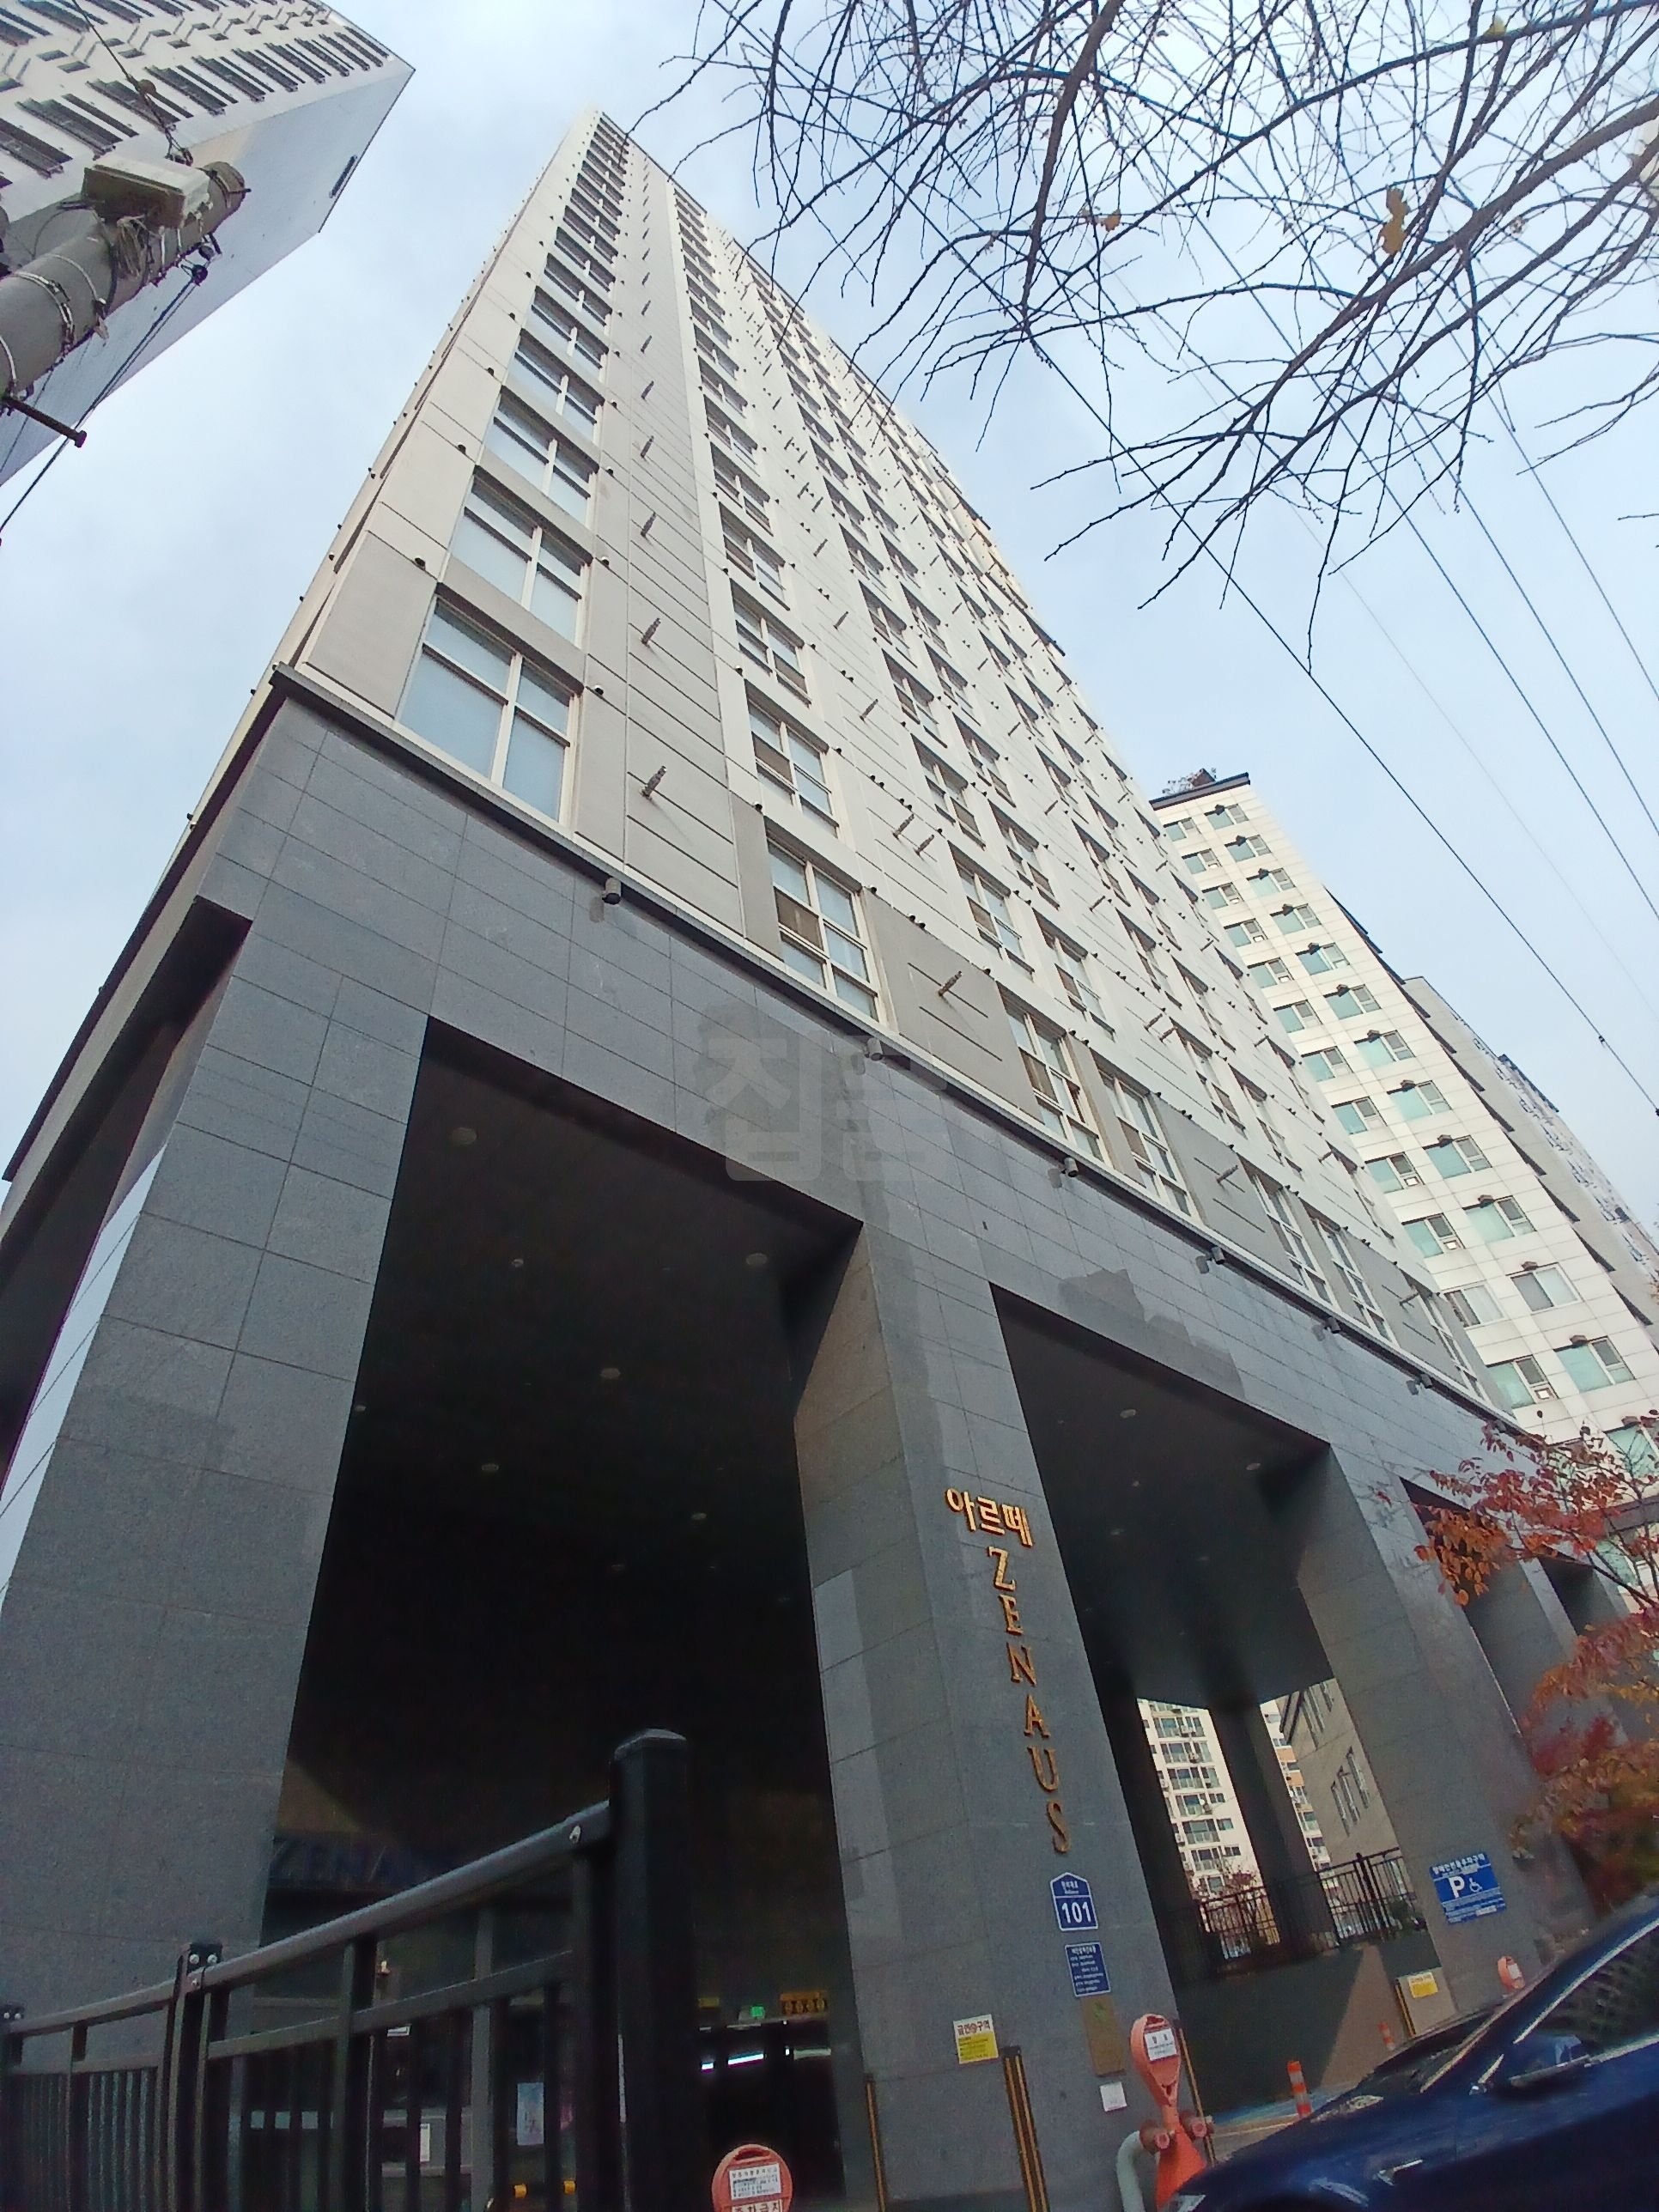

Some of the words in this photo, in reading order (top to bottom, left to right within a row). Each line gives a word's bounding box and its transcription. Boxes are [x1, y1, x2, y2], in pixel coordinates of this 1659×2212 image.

[946, 1488, 1033, 1547] 아르떼
[987, 1546, 1071, 1854] ZENAUS
[1448, 1875, 1465, 1899] P
[1061, 1901, 1091, 1923] 101
